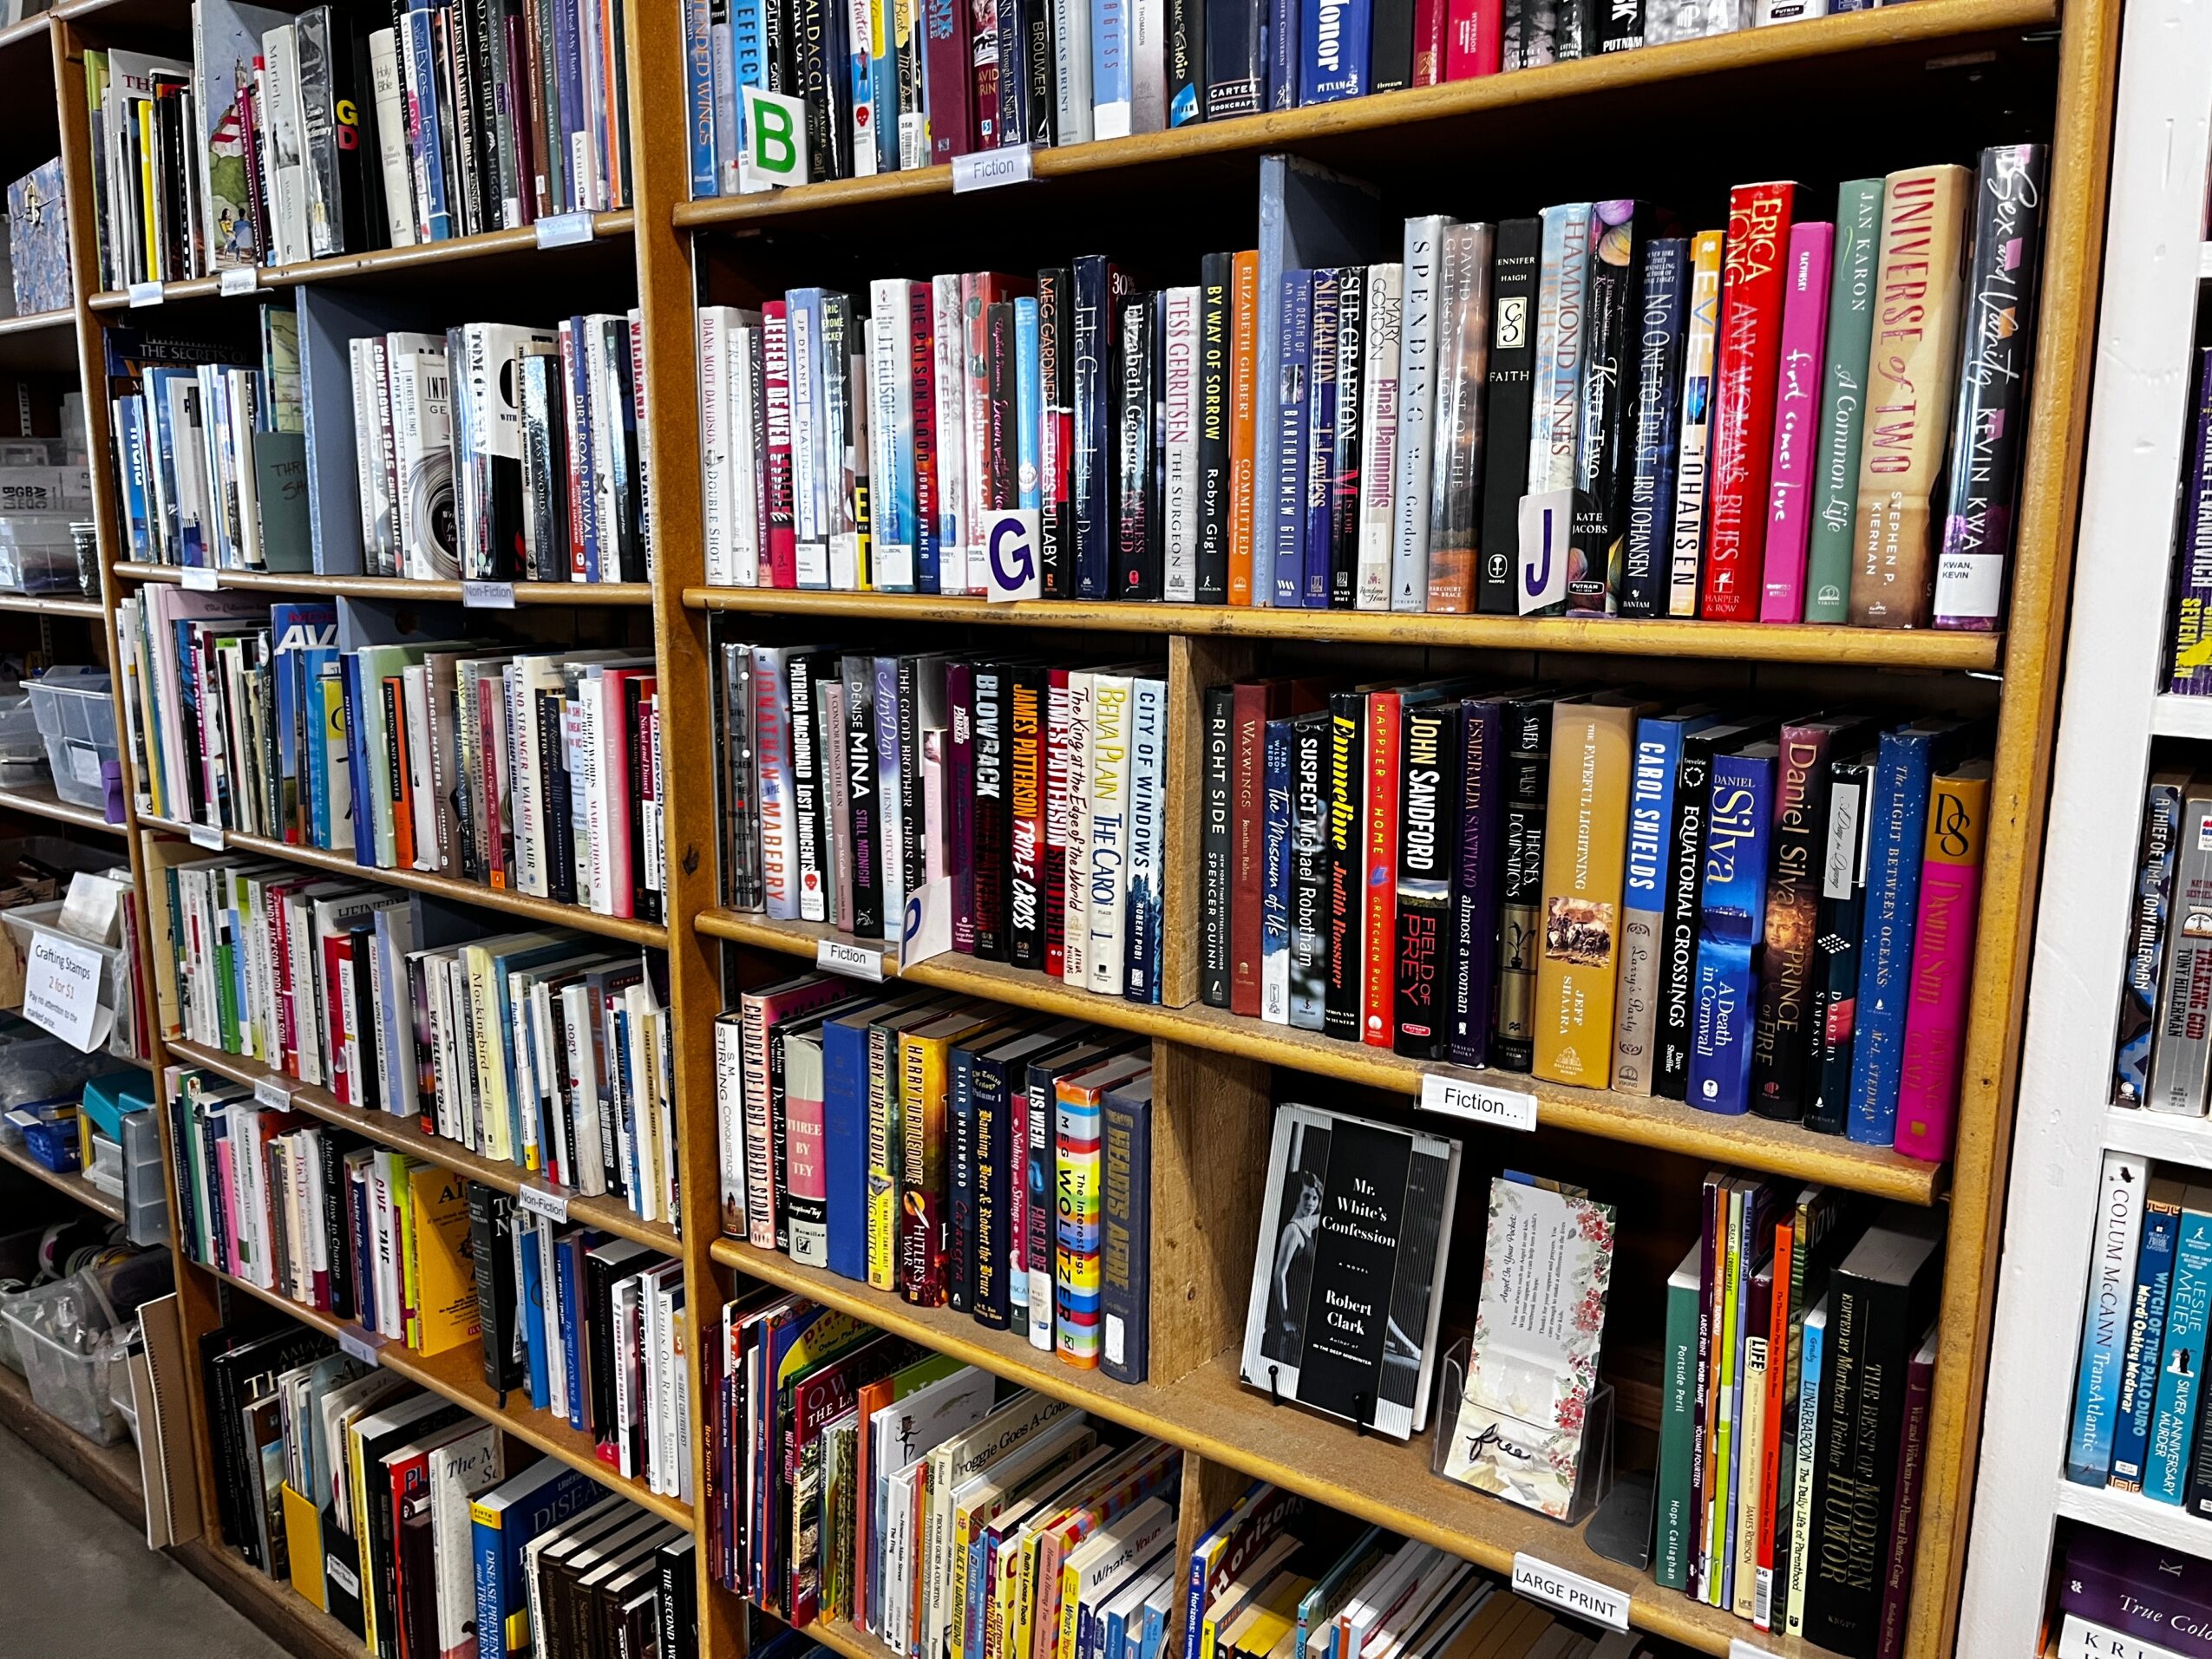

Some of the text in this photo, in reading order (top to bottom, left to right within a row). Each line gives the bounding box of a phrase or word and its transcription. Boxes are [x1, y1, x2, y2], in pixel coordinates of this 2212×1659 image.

[1032, 22, 1047, 96] BROUWER
[1602, 36, 1643, 51] PUTNAM
[1210, 82, 1257, 98] CARTER
[1210, 100, 1257, 112] BOOKCRAFT
[753, 98, 796, 173] B
[974, 159, 1013, 179] Fiction
[1501, 272, 1527, 283] HAIGH
[1850, 193, 1874, 311] JAN KARON
[1406, 240, 1429, 422] SPENDING
[1870, 177, 1936, 473] UNIVERSE of TWO
[631, 322, 645, 420] WILDLAND
[763, 314, 789, 446] JEFFERY DEAVER
[1125, 304, 1144, 474] Elizabeth George
[1489, 370, 1529, 382] FAITH
[912, 293, 930, 559] THE POISON FLOOD JORDAN FARMER
[1167, 297, 1189, 567] TESS GERRITSEN THE SURGEON
[1203, 286, 1222, 554] BY WAY OF SORROW Robyn Gigl
[1773, 349, 1811, 522] first comes love
[578, 434, 589, 474] ROAD
[1827, 365, 1858, 532] A Common Life
[580, 480, 591, 539] REVIVAL
[1572, 523, 1607, 534] JACOBS
[1575, 513, 1603, 522] KATE
[989, 518, 1035, 591] G
[1526, 509, 1552, 596] J
[1866, 502, 1882, 575] KIERNAN
[1882, 491, 1901, 586] STEPHEN P.
[1943, 562, 1973, 571] KWAN,
[466, 581, 512, 598] Non-Fiction
[1942, 571, 1968, 579] KEVIN
[975, 674, 1000, 799] BLOWBACK
[851, 682, 870, 888] DENISE MINA STILL MIDNIGHT
[1012, 683, 1037, 931] JAMES PATTERSON TRIPLE CROSS
[1407, 715, 1442, 870] JOHN SANDFORD
[1714, 774, 1755, 787] DANIEL
[1134, 693, 1155, 960] CITY OF WINDOWS ROBERT POBI
[1629, 741, 1666, 890] CAROL SHIELDS
[1707, 787, 1755, 885] Silva
[1207, 718, 1226, 970] RIGHT SIDE SPENCER QUINN
[1299, 738, 1318, 968] SUSPECT Michael Robotham
[1670, 805, 1699, 1029] EQUATORIAL CROSSINGS
[2135, 893, 2161, 990] TONY HILLERMAN
[36, 945, 90, 979] Crafting Stamps
[831, 945, 866, 964] Fiction
[1401, 913, 1420, 1006] PREY
[1417, 917, 1436, 1006] FIELD OF
[1457, 895, 1474, 1014] almost a woman
[49, 976, 74, 998] 2 for $1
[1697, 966, 1715, 1056] in Cornwall
[1715, 981, 1733, 1047] A Death
[473, 972, 490, 1070] Mockingbird
[567, 1023, 577, 1055] oogy
[788, 1119, 821, 1136] THREE
[869, 1032, 885, 1169] HARRY TURTLEDOVE
[906, 1045, 924, 1185] HARRY TURTLEDOVE
[958, 1066, 967, 1187] BLAIR UNDERWOOD
[1029, 1086, 1044, 1148] LIS WIEHL
[1445, 1087, 1524, 1120] Fiction...
[324, 1140, 335, 1185] Michael
[793, 1163, 814, 1177] TEY
[796, 1142, 810, 1154] BY
[521, 1192, 564, 1217] Non-Fiction
[1338, 1196, 1388, 1221] White's
[1353, 1179, 1375, 1196] Mr.
[331, 1222, 337, 1233] to
[375, 1179, 389, 1264] GIVE TAKE
[1057, 1116, 1071, 1326] MEG WOLITZER
[1322, 1216, 1396, 1248] Confession
[332, 1235, 341, 1279] Change
[1326, 1290, 1372, 1316] Robert
[1327, 1312, 1365, 1336] Clark
[2081, 1190, 2129, 1453] COLUM McCANN TransAtlantic
[2174, 1269, 2200, 1335] MEIER
[2190, 1279, 2207, 1332] LESLIE
[1678, 1344, 1688, 1387] Portside
[1749, 1339, 1768, 1372] LIFE
[661, 1381, 670, 1419] REACH
[1675, 1388, 1685, 1413] Peril
[1466, 1422, 1531, 1463] free
[2154, 1411, 2171, 1458] MURDER
[784, 1449, 793, 1485] PURSUIT
[485, 1551, 496, 1603] DISEASE
[1668, 1529, 1679, 1579] Callaghan
[665, 1594, 675, 1640] SECOND
[1515, 1569, 1616, 1617] LARGE PRINT
[2119, 1595, 2164, 1623] True
